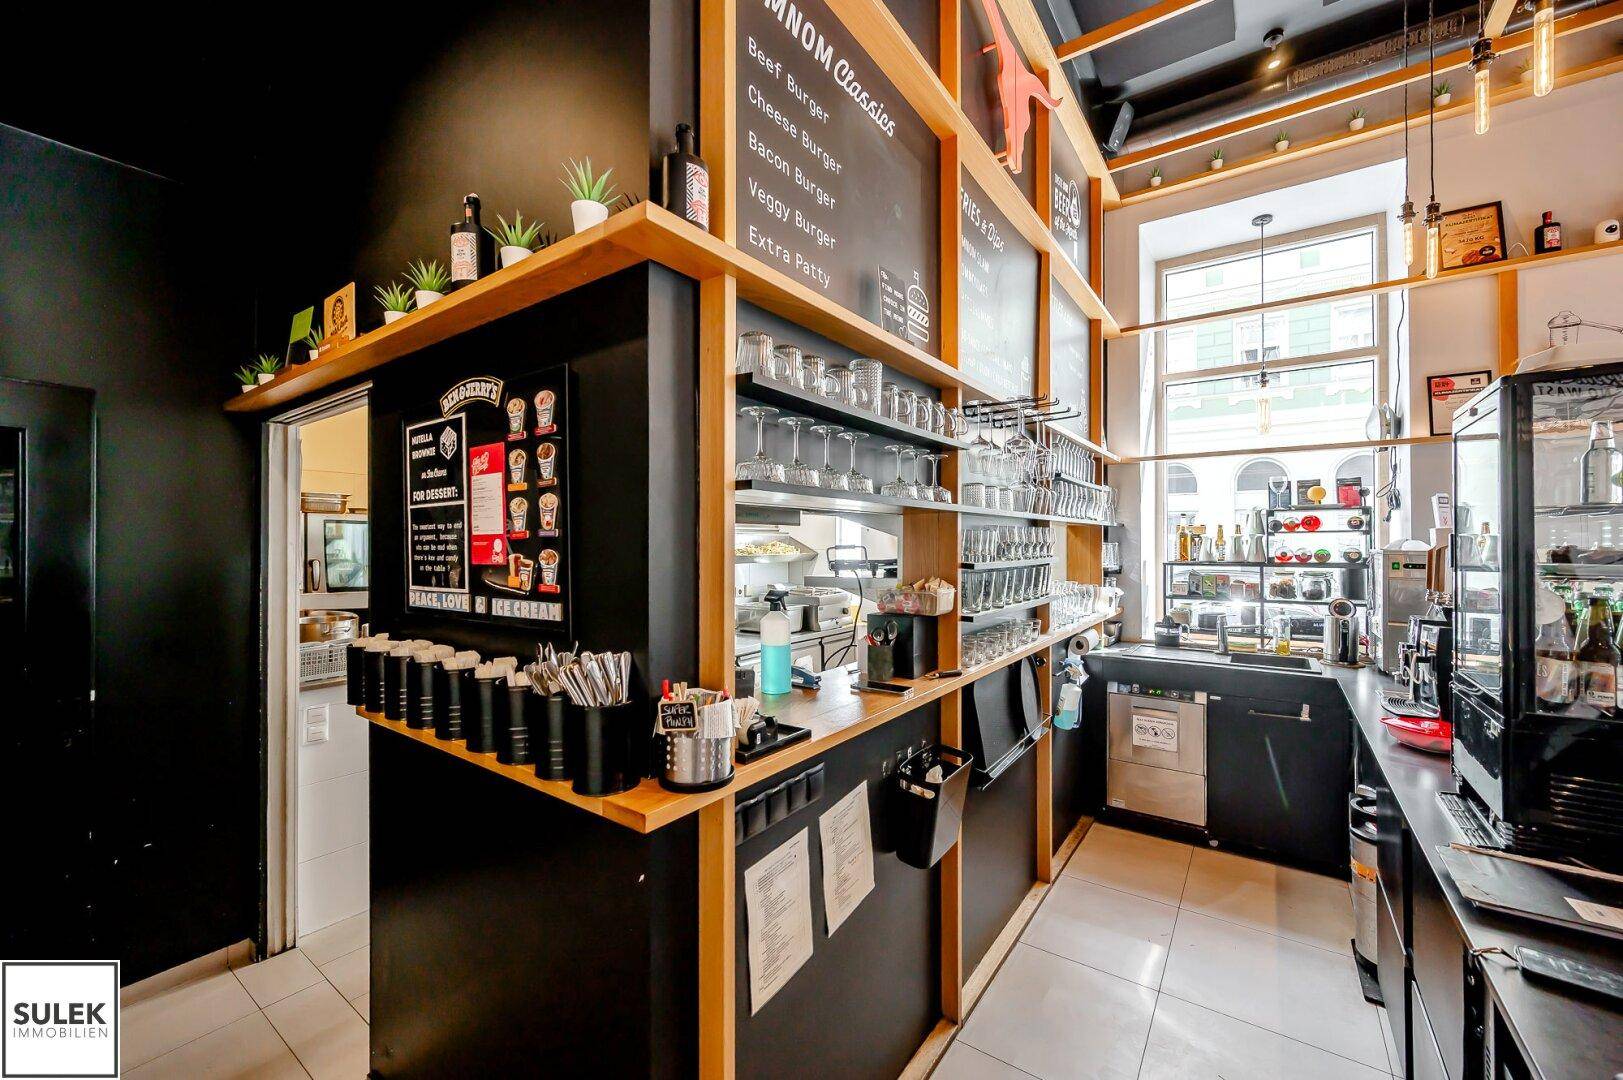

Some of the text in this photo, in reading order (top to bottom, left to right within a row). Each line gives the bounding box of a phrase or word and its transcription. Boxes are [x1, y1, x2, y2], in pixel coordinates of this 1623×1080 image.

[748, 36, 829, 124] Beef Burger
[833, 59, 896, 137] Classics
[748, 84, 842, 175] Cheese Burger
[749, 130, 836, 209] Bacon Burger
[749, 177, 836, 249] Veggy Burger
[1054, 187, 1071, 223] BEER
[749, 225, 831, 289] Extra Patty
[987, 223, 1005, 253] Dips
[411, 433, 433, 446] NUTELLA
[411, 447, 436, 460] BROWNIE
[413, 486, 458, 502] FOR DESSERT:
[409, 592, 440, 610] PEACE,
[442, 594, 469, 611] LOVE
[492, 598, 511, 615] ICE
[514, 599, 562, 621] CREAM
